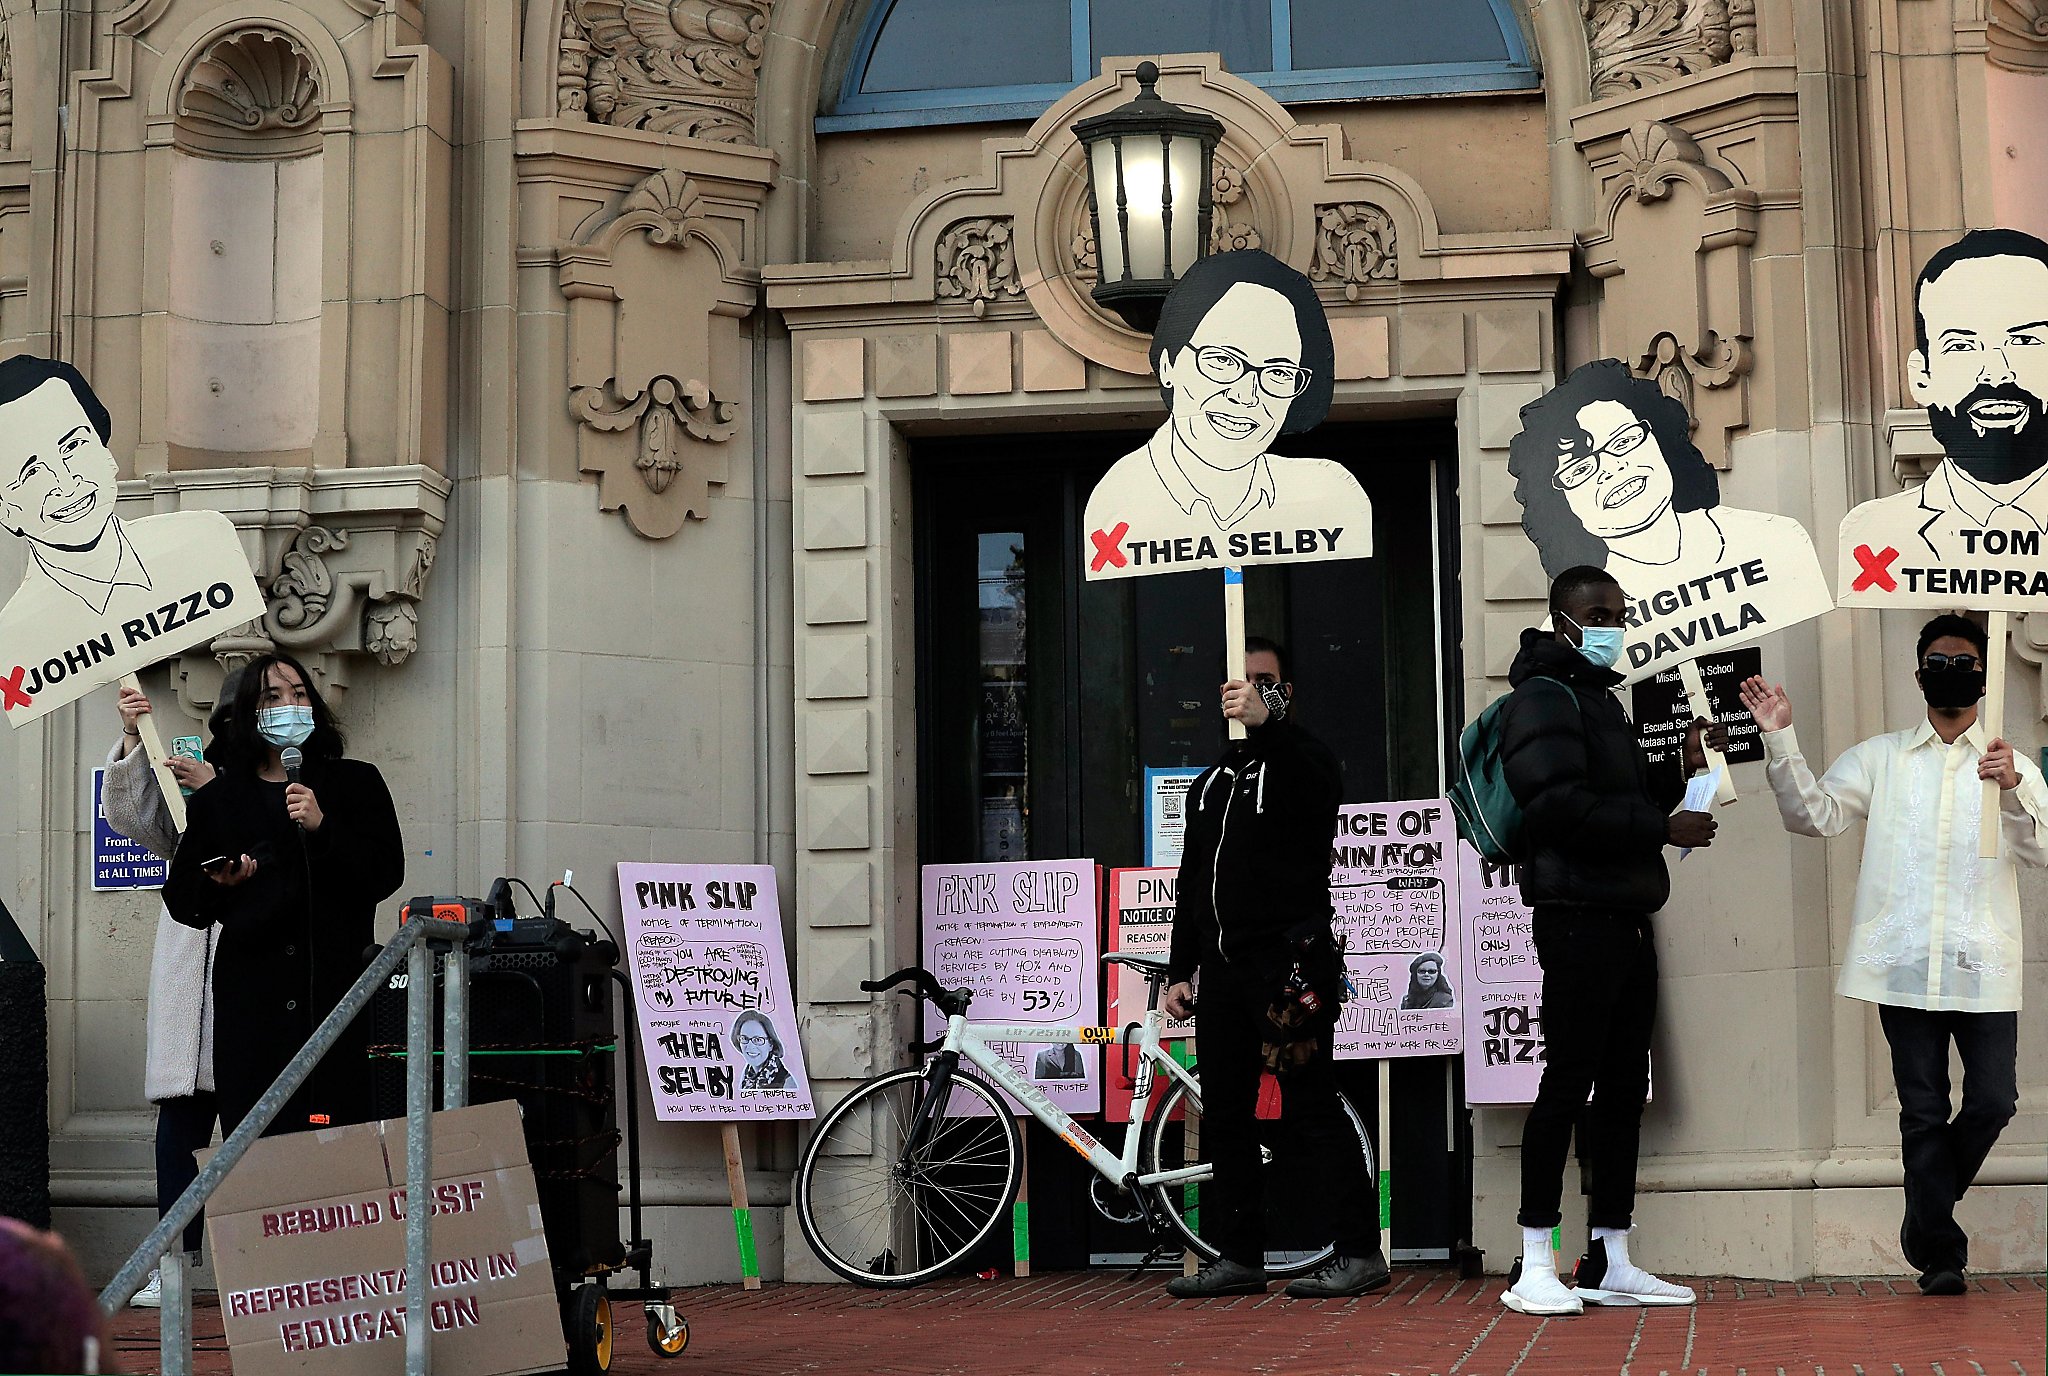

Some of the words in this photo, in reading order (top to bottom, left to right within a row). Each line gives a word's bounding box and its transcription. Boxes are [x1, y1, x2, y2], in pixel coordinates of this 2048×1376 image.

[1127, 535, 1218, 566] THEA
[1228, 527, 1344, 558] SELBY
[1959, 529, 2039, 556] TOM
[1901, 568, 2048, 597] TEMPRA
[1624, 558, 1769, 631] RIGITTE
[25, 632, 116, 695] JOHN
[121, 582, 234, 648] RIZZO
[1626, 602, 1767, 670] DAVILA
[1656, 671, 1682, 684] Missio
[1707, 662, 1734, 676] School
[1643, 721, 1674, 734] Escuela
[1721, 710, 1751, 723] Mission
[1667, 735, 1678, 745] na
[1727, 724, 1758, 737] Mission
[1397, 808, 1441, 837] OF
[105, 837, 132, 847] Front
[98, 853, 125, 862] must
[127, 852, 141, 862] be
[1331, 842, 1442, 869] MINATION
[99, 870, 109, 878] at
[111, 868, 130, 878] ALL
[133, 866, 163, 878] TIMES!
[635, 881, 696, 912] PINK
[705, 881, 757, 911] SLIP
[936, 873, 1000, 915] PINK
[1012, 871, 1079, 914] SLIP
[1138, 878, 1176, 903] PIN
[1361, 889, 1375, 901] TO
[1383, 890, 1404, 900] USE
[1409, 890, 1440, 900] COVID
[1345, 902, 1383, 913] FUNDS
[1390, 903, 1404, 912] TO
[1410, 902, 1439, 913] SAVE
[1481, 896, 1516, 905] NOTICE
[640, 918, 672, 928] NOTICE
[679, 919, 690, 928] OF
[1123, 909, 1162, 923] NOTICE
[1382, 915, 1402, 925] AND
[1409, 914, 1435, 925] ARE
[935, 921, 959, 931] NOTICE
[1396, 926, 1441, 939] PEOPLE
[1479, 925, 1501, 937] YOU
[1506, 923, 1533, 936] ARE
[1480, 939, 1510, 952] ONLY
[673, 949, 694, 964] YOU
[703, 947, 733, 963] ARE
[941, 952, 958, 960] YOU
[963, 950, 984, 959] ARE
[989, 948, 1028, 957] CUTTING
[1033, 948, 1079, 959] DISABILITY
[1481, 955, 1526, 967] STUDIES
[940, 962, 987, 972] SERVICES
[994, 961, 1009, 971] BY
[1016, 960, 1042, 972] 40%
[1048, 962, 1072, 973] AND
[662, 965, 760, 992] DESTROYING
[979, 975, 993, 984] AS
[999, 974, 1007, 984] A
[1015, 975, 1061, 985] SECOND
[1001, 991, 1016, 1005] BY
[1481, 991, 1527, 1002] EMPLOYEE
[1402, 1022, 1449, 1034] TRUSTEE
[1483, 1005, 1544, 1038] JOH
[1083, 1027, 1111, 1038] OUT
[656, 1032, 725, 1061] THEA
[1364, 1041, 1381, 1050] THAT
[1384, 1040, 1397, 1050] YOU
[1400, 1041, 1421, 1051] WORK
[1424, 1039, 1441, 1050] FOR
[1482, 1038, 1547, 1067] RIZZ
[657, 1065, 734, 1100] SELBY
[1052, 1083, 1089, 1093] TRUSTEE
[740, 1090, 757, 1100] CCSF
[762, 1089, 797, 1099] TRUSTEE
[667, 1105, 684, 1114] HOW
[740, 1104, 750, 1113] TO
[754, 1103, 774, 1113] LOSE
[775, 1103, 794, 1113] YOUR
[262, 1200, 383, 1238] REBUILD
[388, 1180, 485, 1222] CSF
[228, 1256, 479, 1318] REPRESENTAION
[487, 1251, 518, 1280] IN
[280, 1295, 480, 1353] EDUCATON
